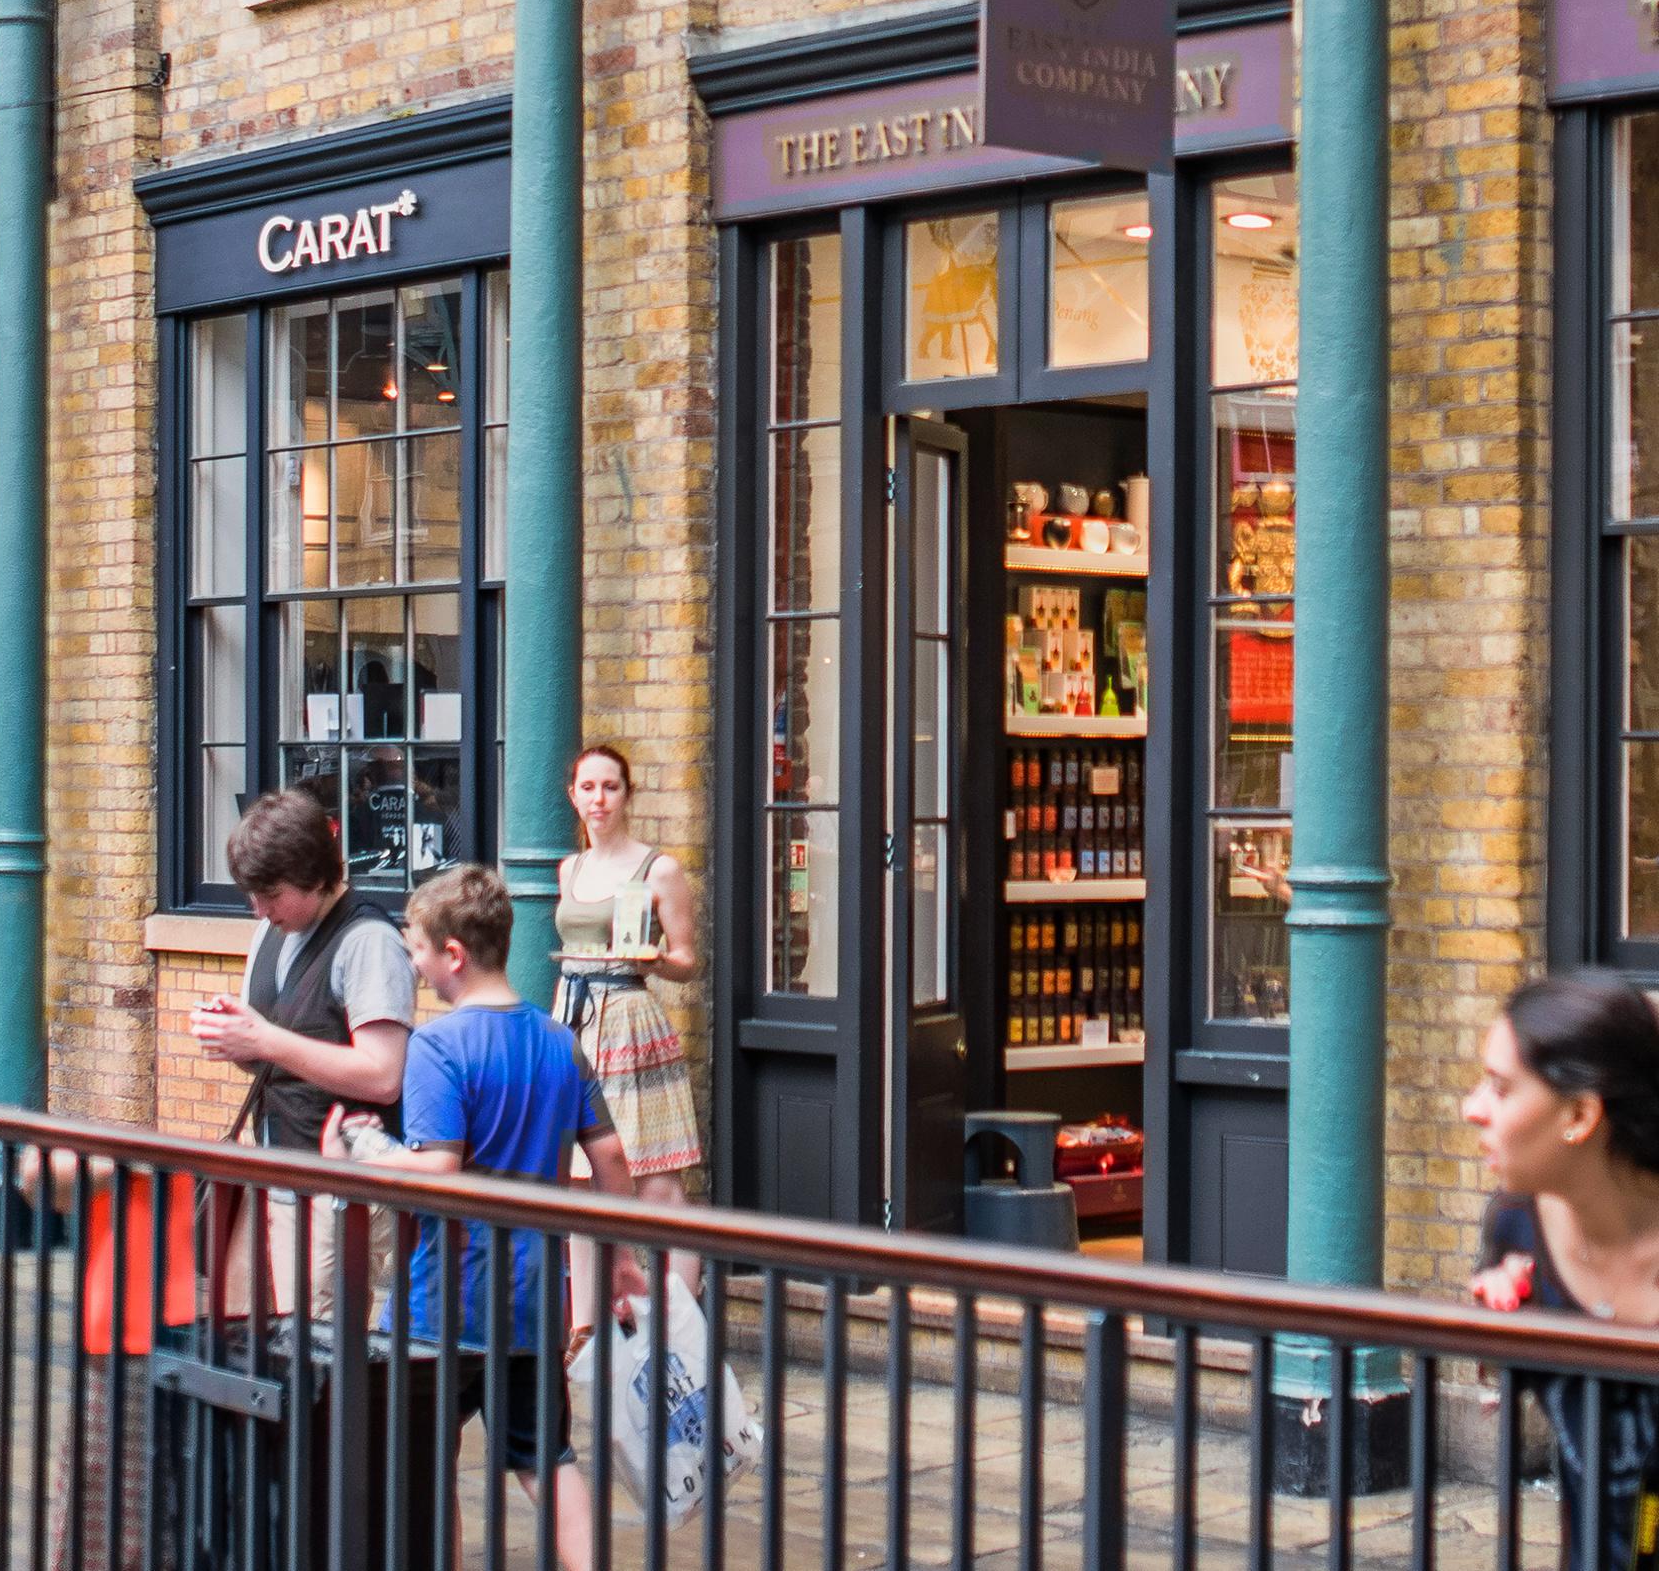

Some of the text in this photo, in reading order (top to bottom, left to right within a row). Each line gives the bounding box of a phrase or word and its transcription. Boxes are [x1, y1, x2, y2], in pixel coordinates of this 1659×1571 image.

[1015, 58, 1150, 106] COMPANY
[1080, 42, 1157, 77] INDIA
[777, 130, 840, 175] THE
[851, 110, 932, 163] EAST
[257, 201, 405, 274] CARAT
[369, 791, 406, 811] CARA
